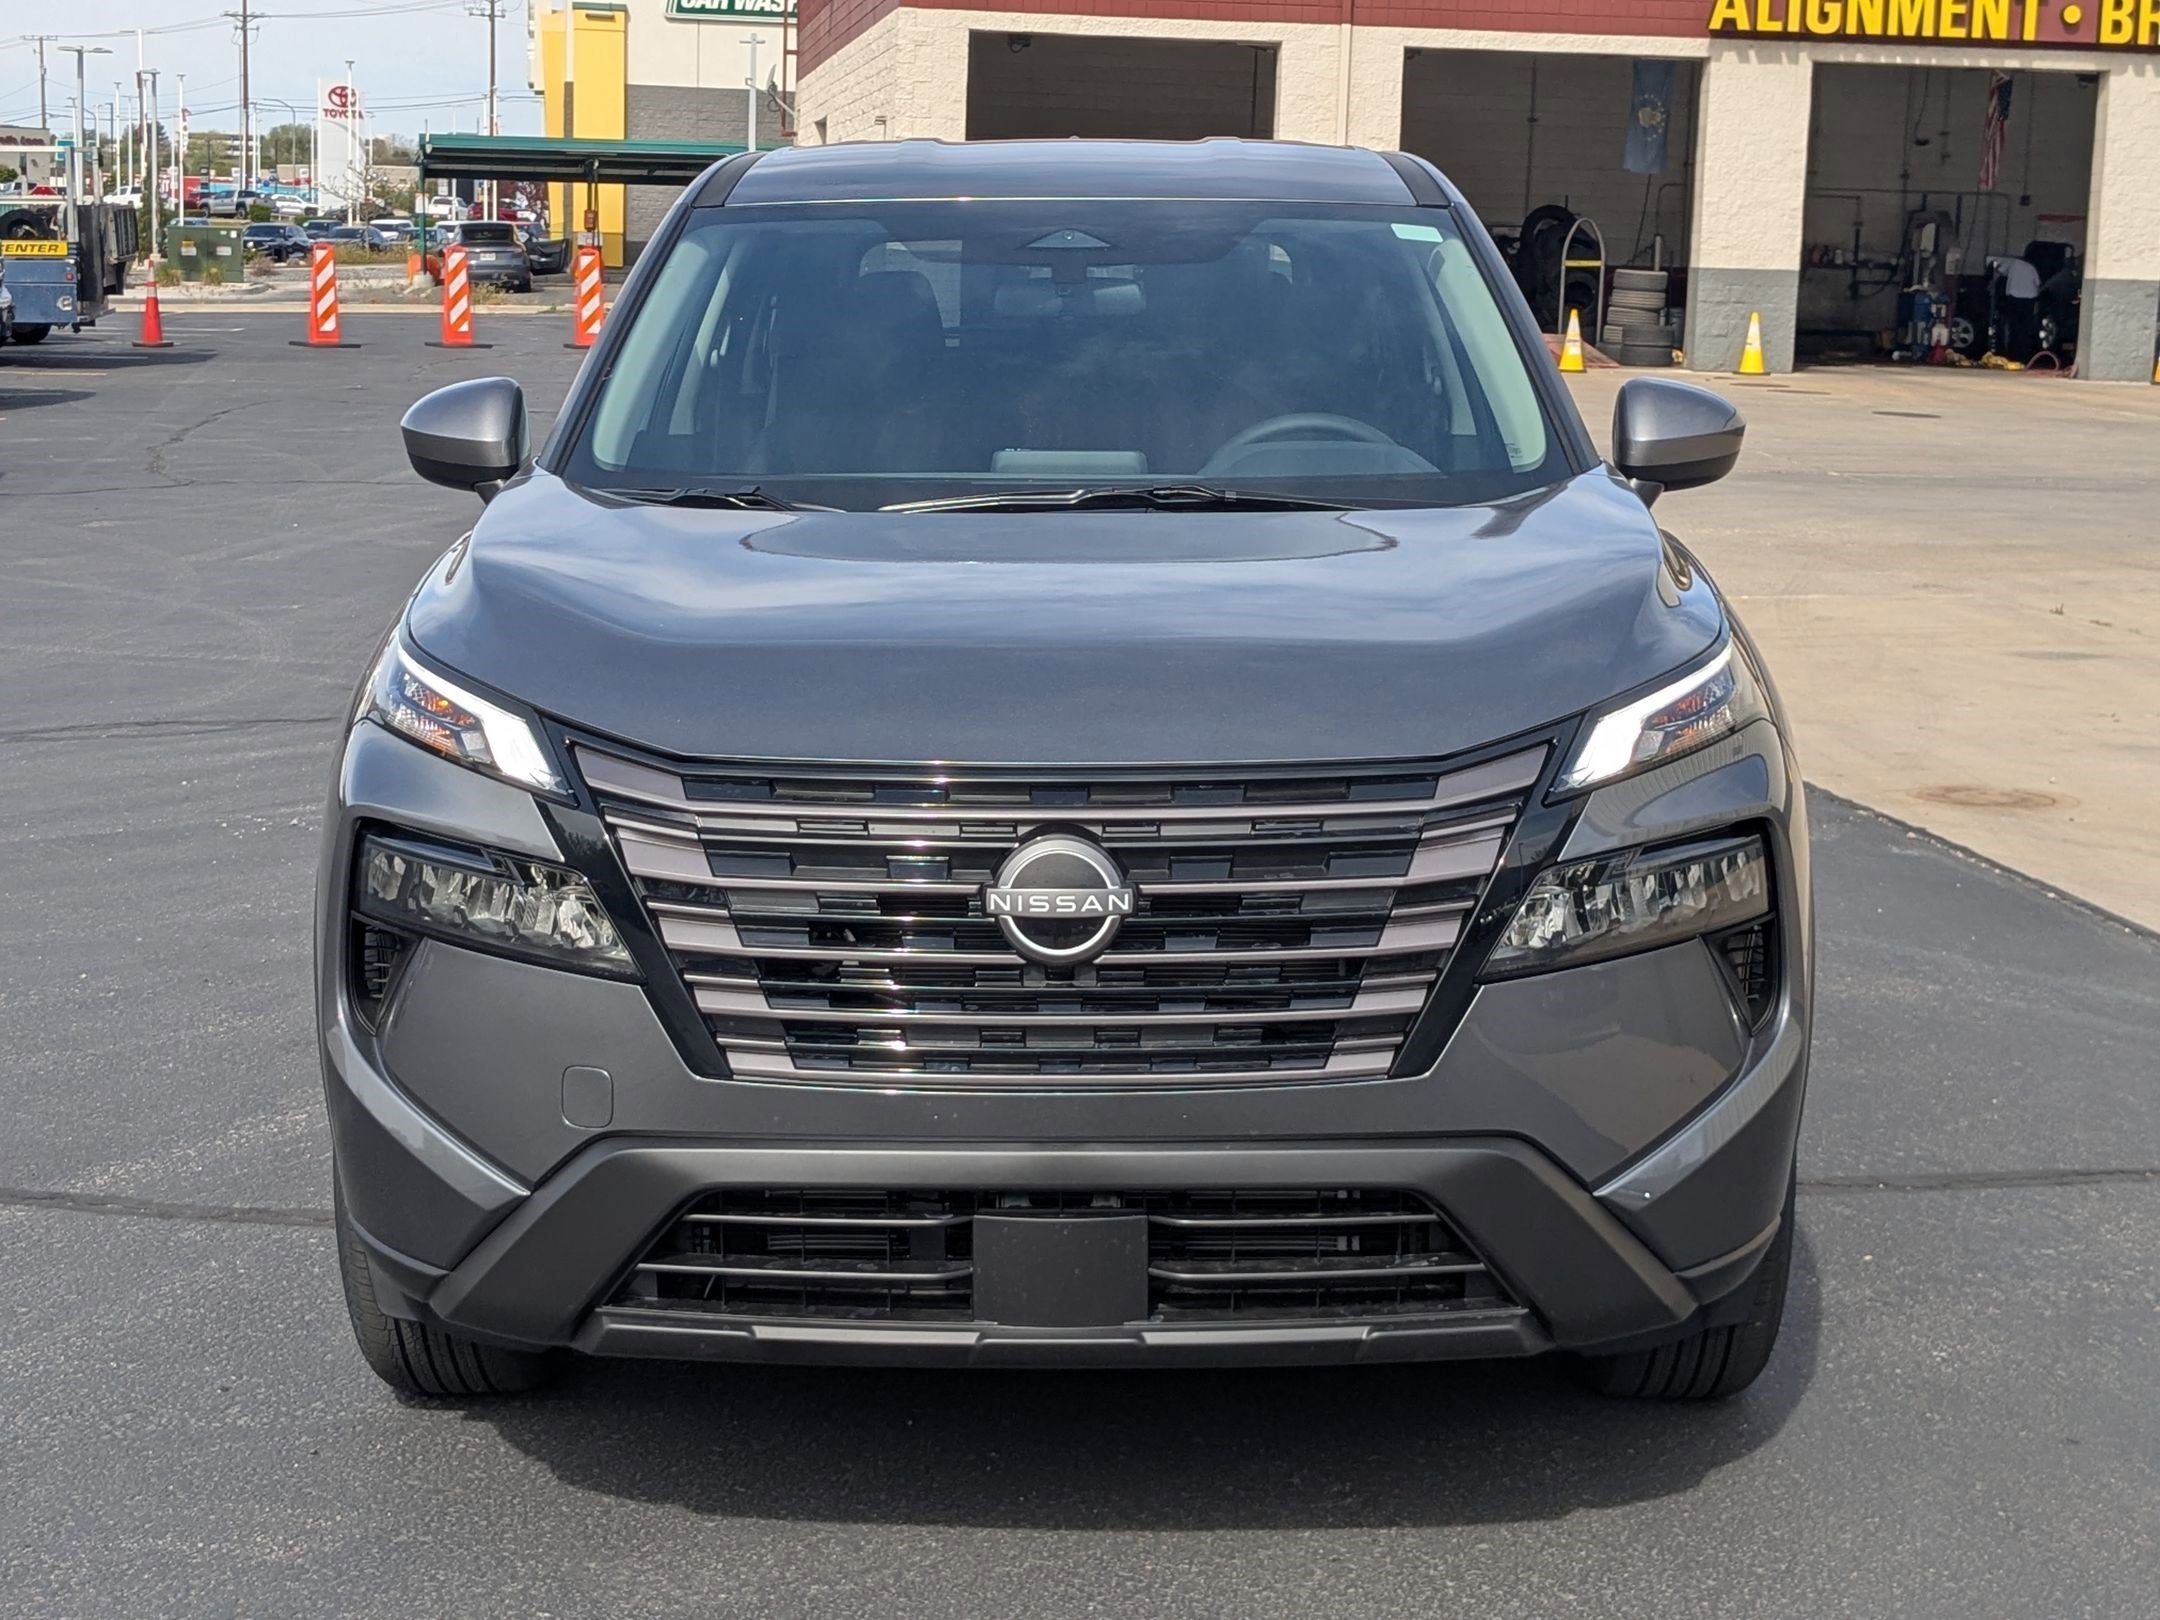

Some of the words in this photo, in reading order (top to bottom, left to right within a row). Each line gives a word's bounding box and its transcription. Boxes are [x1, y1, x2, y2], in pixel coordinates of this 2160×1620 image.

[1708, 0, 2039, 41] ALIGNMENT
[0, 243, 60, 253] ENTER
[989, 893, 1130, 913] NISSAN
